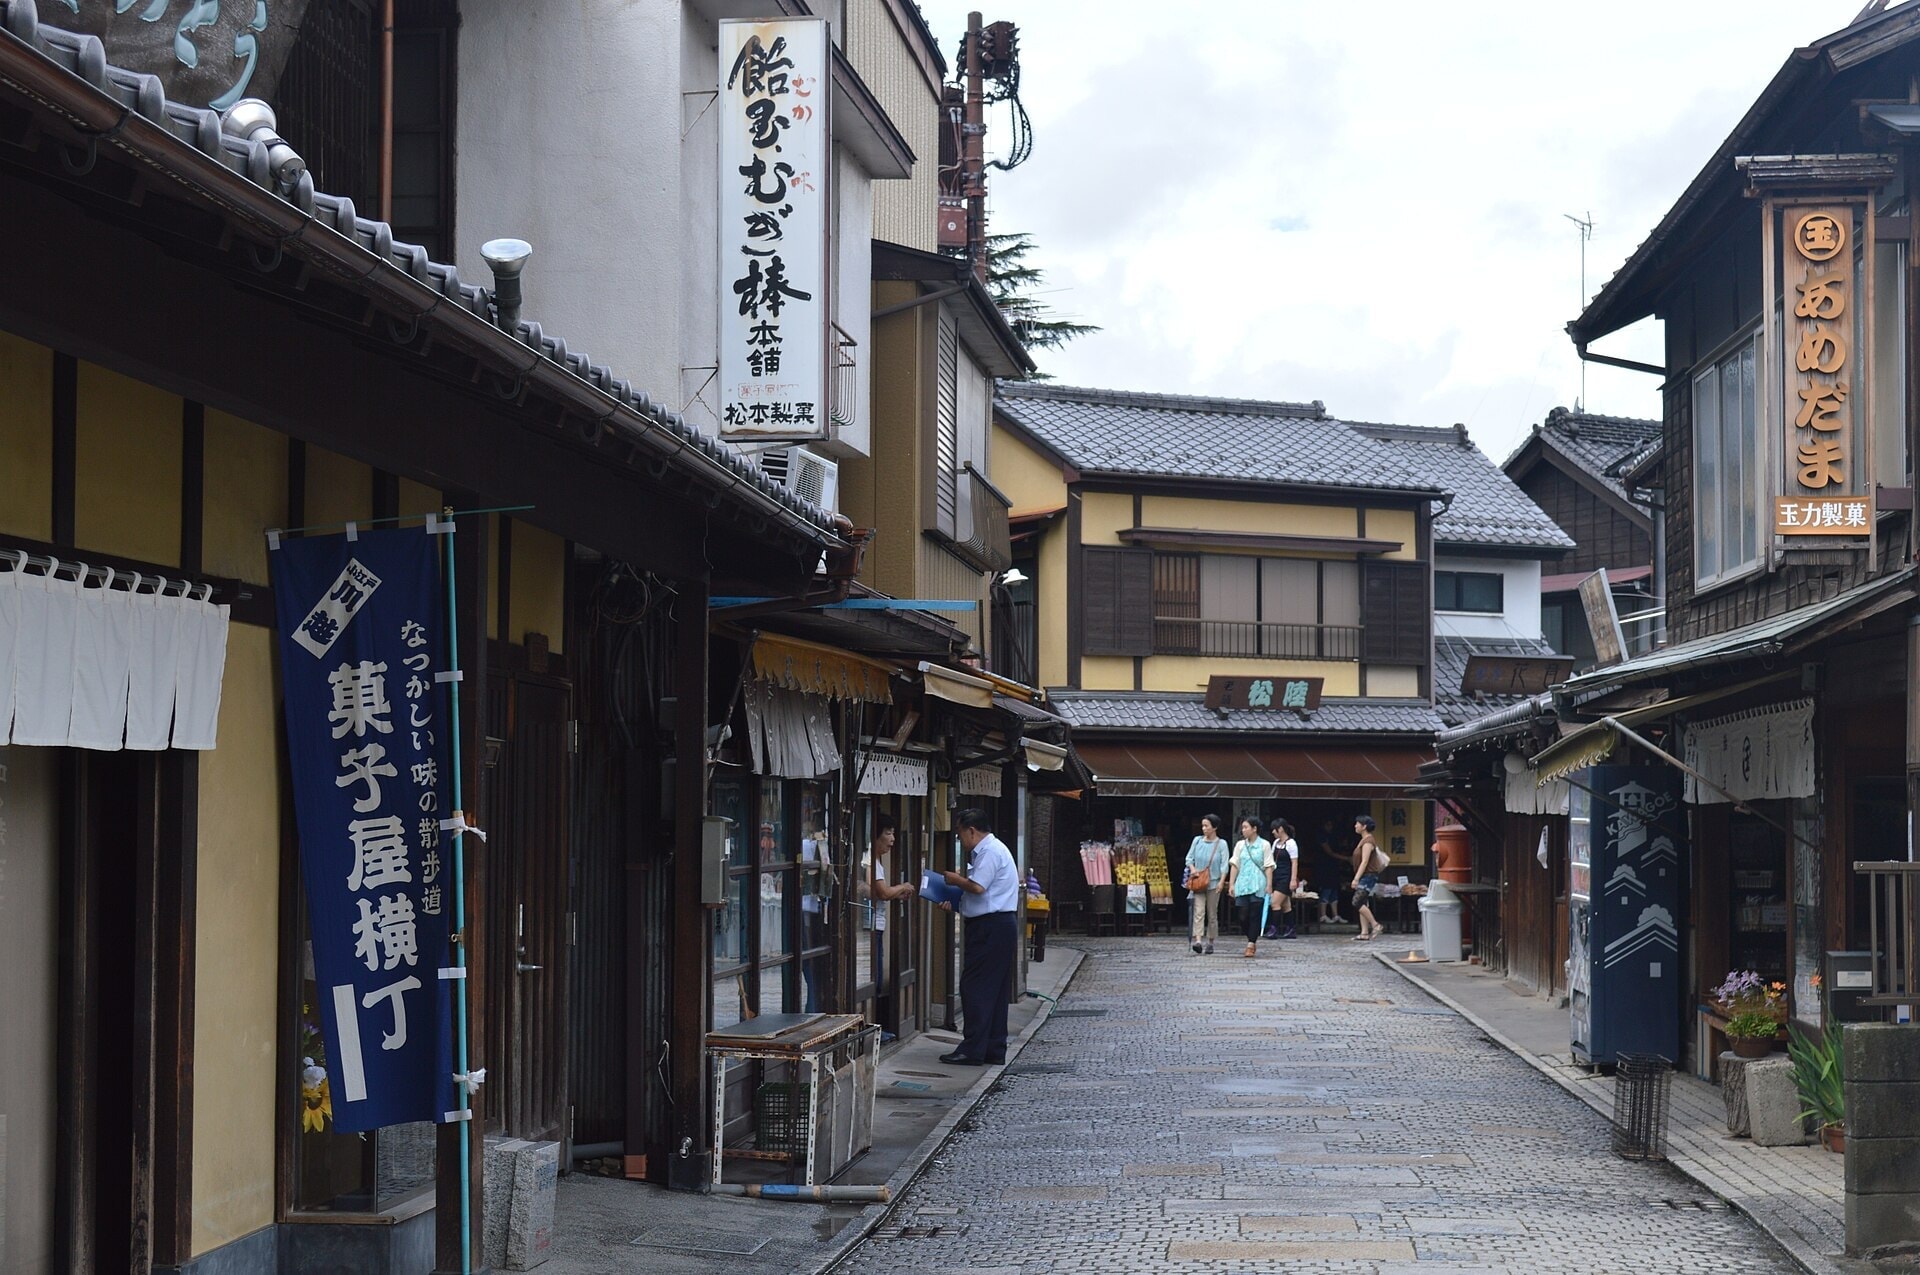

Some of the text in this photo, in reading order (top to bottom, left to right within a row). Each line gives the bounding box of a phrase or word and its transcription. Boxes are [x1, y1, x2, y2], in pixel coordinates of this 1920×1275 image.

[723, 402, 815, 426] 松本製菓
[1778, 502, 1867, 528] 玉力製菓
[346, 564, 377, 589] 小江戸
[302, 579, 364, 646] 川越
[328, 660, 423, 1051] 菓子屋横丁
